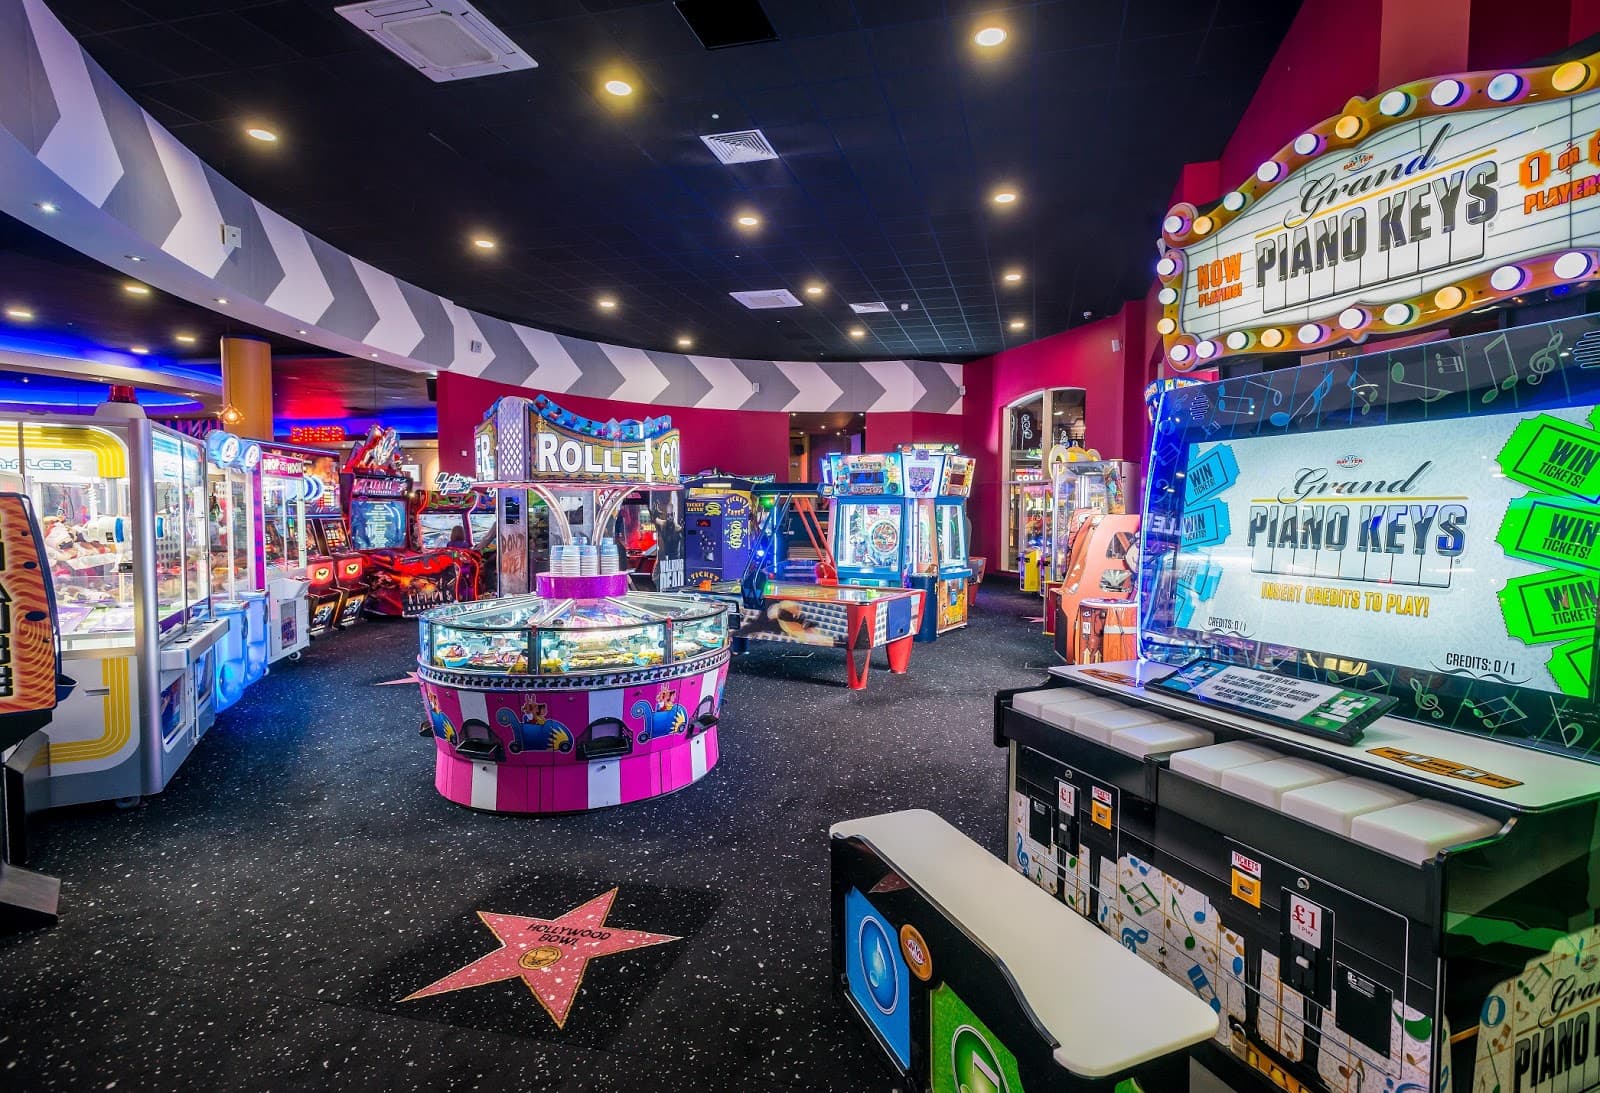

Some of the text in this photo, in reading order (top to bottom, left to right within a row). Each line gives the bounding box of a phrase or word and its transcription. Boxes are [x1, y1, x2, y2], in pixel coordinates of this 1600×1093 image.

[1284, 122, 1453, 229] Grand
[1523, 174, 1600, 215] PLAYER
[1255, 160, 1498, 288] PIANO KEYS
[1197, 252, 1242, 291] NOW
[1198, 282, 1243, 308] PLAYING!
[538, 433, 655, 477] ROLLER
[1549, 438, 1600, 476] WIN
[1189, 463, 1213, 488] WIN
[1277, 461, 1433, 504] Grand
[1539, 461, 1586, 488] TICKETS!
[1183, 512, 1206, 533] WIN
[1247, 504, 1468, 558] PIANO KEYS
[1549, 514, 1600, 547] WIN
[1542, 538, 1592, 560] TICKETS!
[1261, 582, 1431, 617] INSERT CREDITS TO PLAY!
[1544, 580, 1597, 612] WIN
[1208, 616, 1234, 630] CREDITS:
[1446, 652, 1491, 672] CREDITS:
[1235, 853, 1259, 872] TICKETS
[527, 923, 612, 941] HOLLYWOOD
[1292, 904, 1318, 931] £1
[538, 933, 580, 946] BOWL
[1514, 1011, 1591, 1093] PIANO
